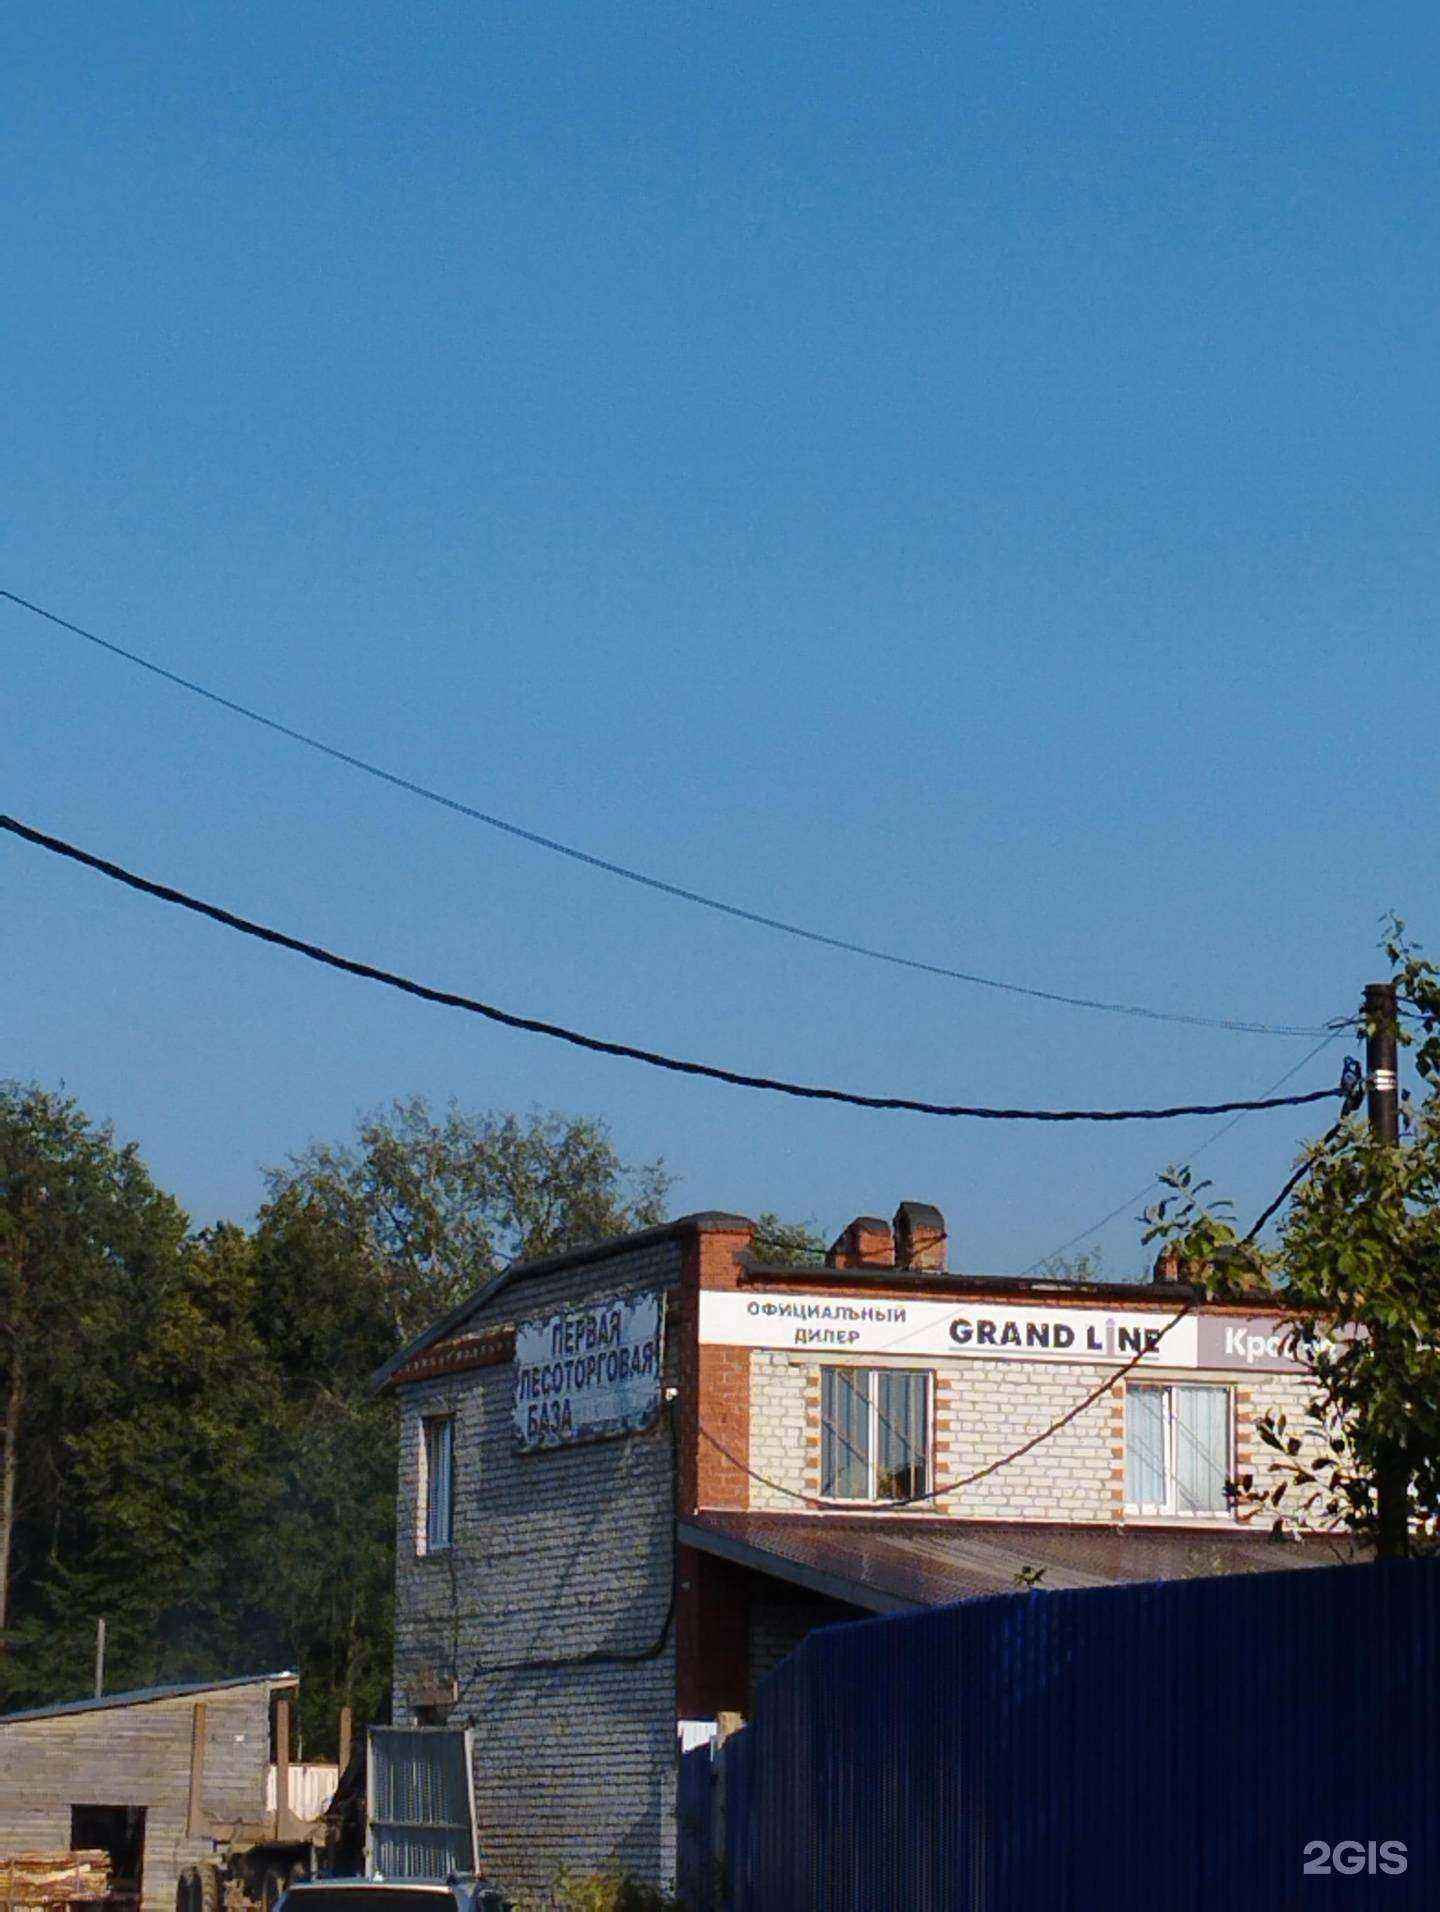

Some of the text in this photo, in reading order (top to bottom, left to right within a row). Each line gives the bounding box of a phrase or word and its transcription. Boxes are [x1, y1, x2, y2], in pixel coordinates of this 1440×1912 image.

[747, 1301, 906, 1323] ОФИЦИАЛЬНЫЙ
[552, 1311, 622, 1357] ПЕРВАЯ
[794, 1328, 860, 1344] ДИЛЕР
[949, 1318, 1075, 1349] GRAND
[519, 1342, 654, 1400] ЛЕСОТОРГОВАЯ
[528, 1398, 573, 1438] БАЗА
